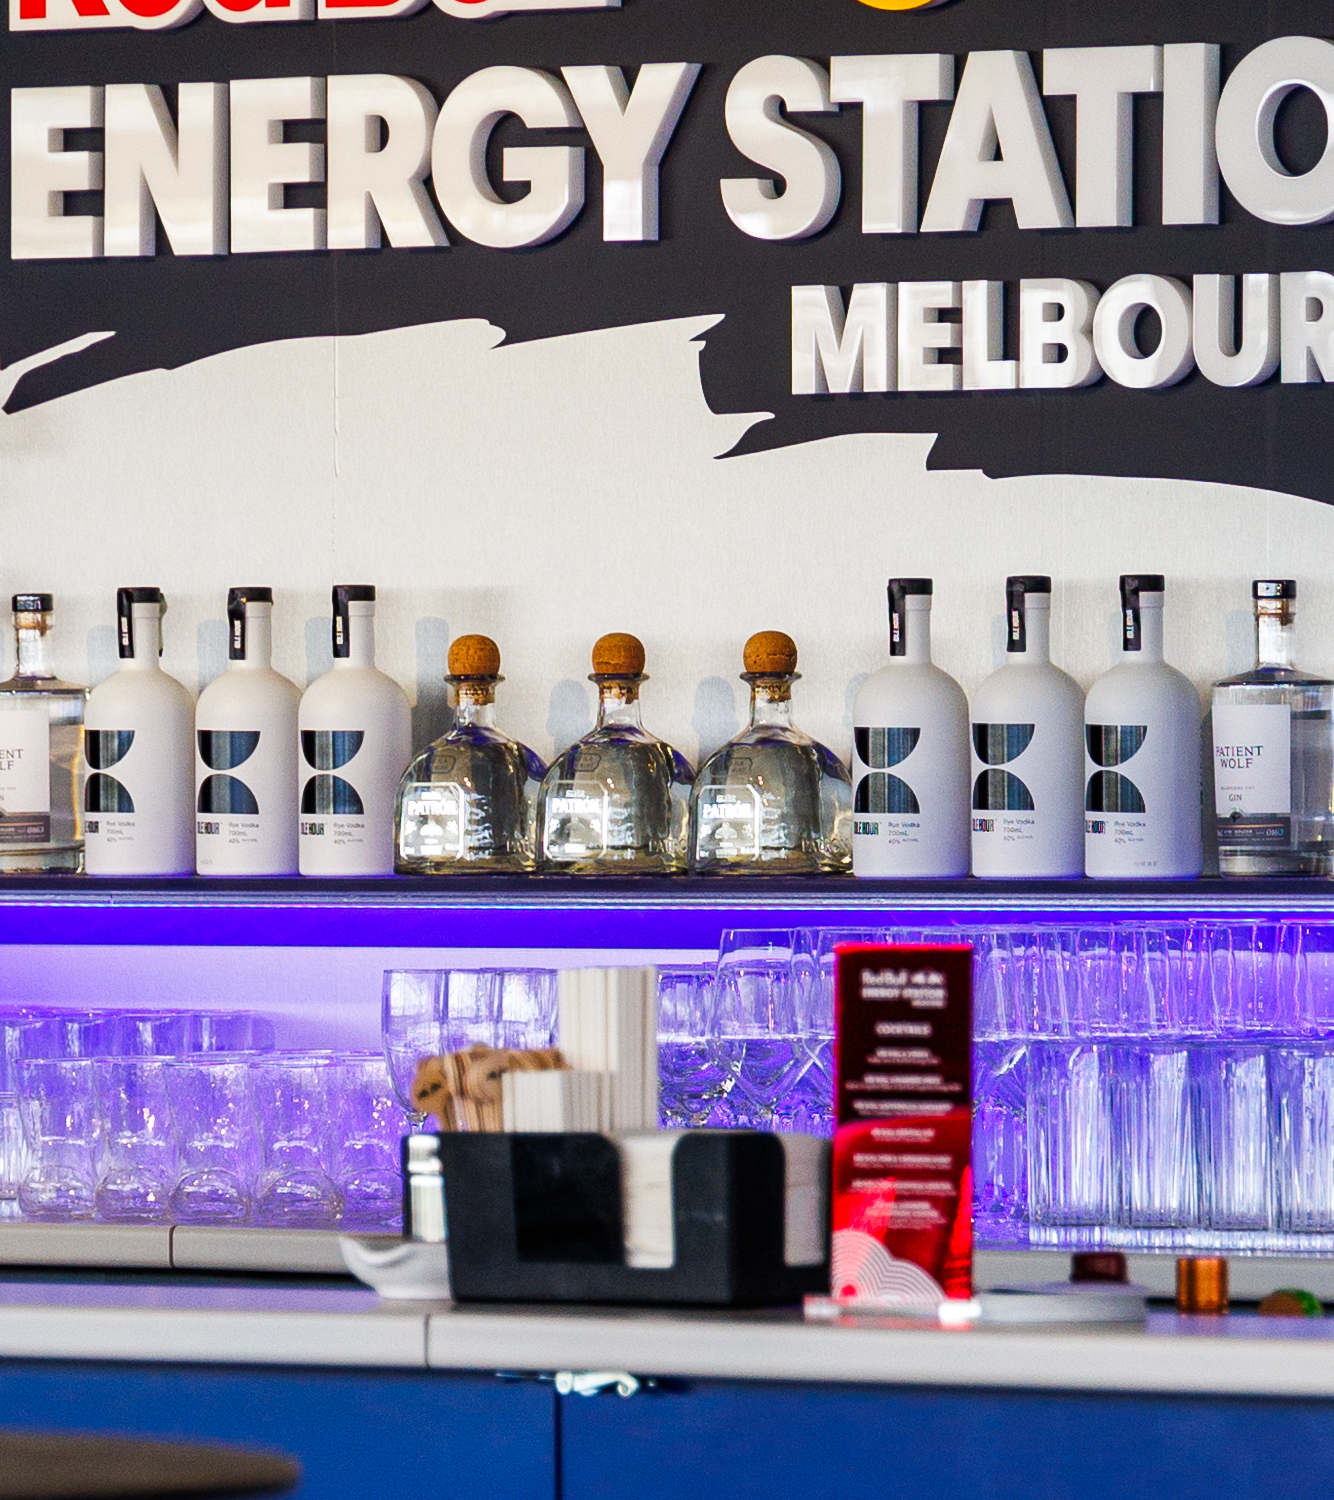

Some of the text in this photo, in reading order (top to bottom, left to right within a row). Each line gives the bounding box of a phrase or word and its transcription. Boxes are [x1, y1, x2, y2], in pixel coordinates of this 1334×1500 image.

[10, 62, 702, 260] ENERGY
[1220, 758, 1253, 769] WOLF
[551, 795, 602, 814] PATRÓN
[703, 800, 753, 819] PATRÓN
